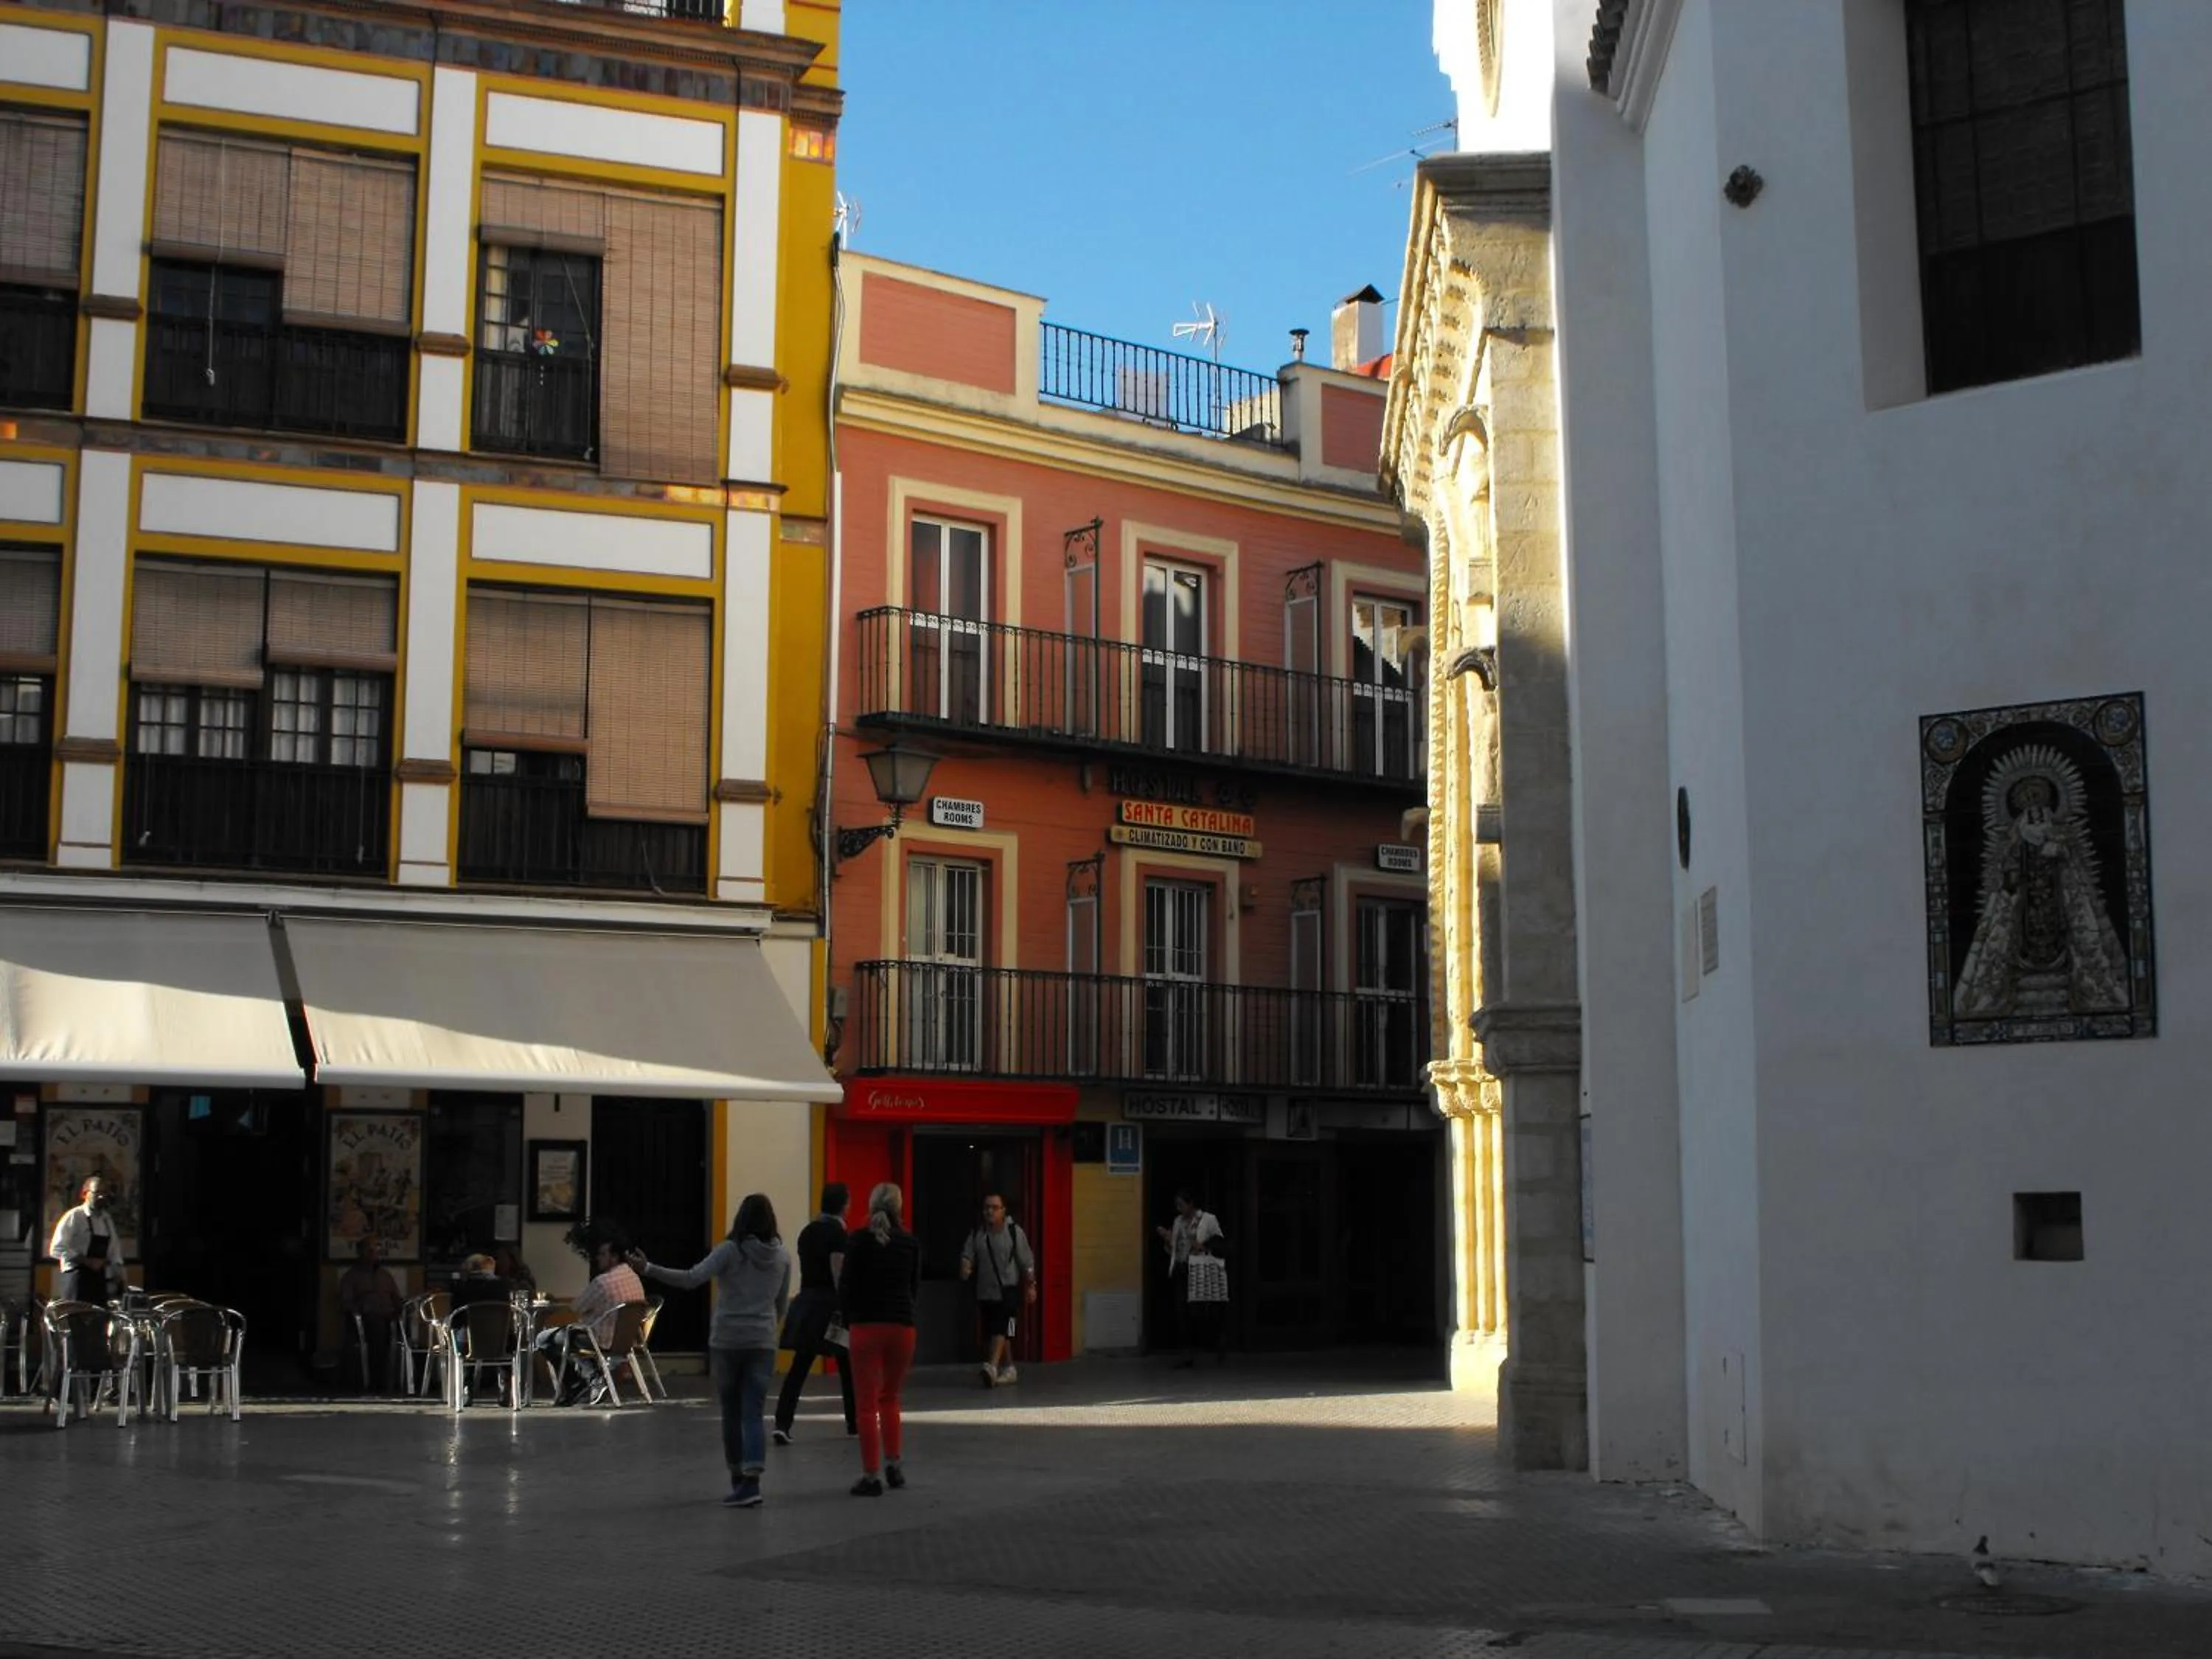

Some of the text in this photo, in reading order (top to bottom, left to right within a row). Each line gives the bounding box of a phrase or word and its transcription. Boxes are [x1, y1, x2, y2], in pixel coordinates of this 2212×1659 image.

[936, 800, 981, 814] CHAMBRES
[944, 812, 973, 824] ROOMS
[1124, 801, 1252, 834] SANTA CATALINA
[1128, 829, 1187, 848] CLIMATIZADO
[1192, 836, 1197, 847] Y
[1200, 838, 1220, 851] CON
[1128, 1094, 1202, 1116] HOSTAL
[57, 1119, 130, 1147] EL PATIO
[341, 1123, 411, 1150] EL PATIO
